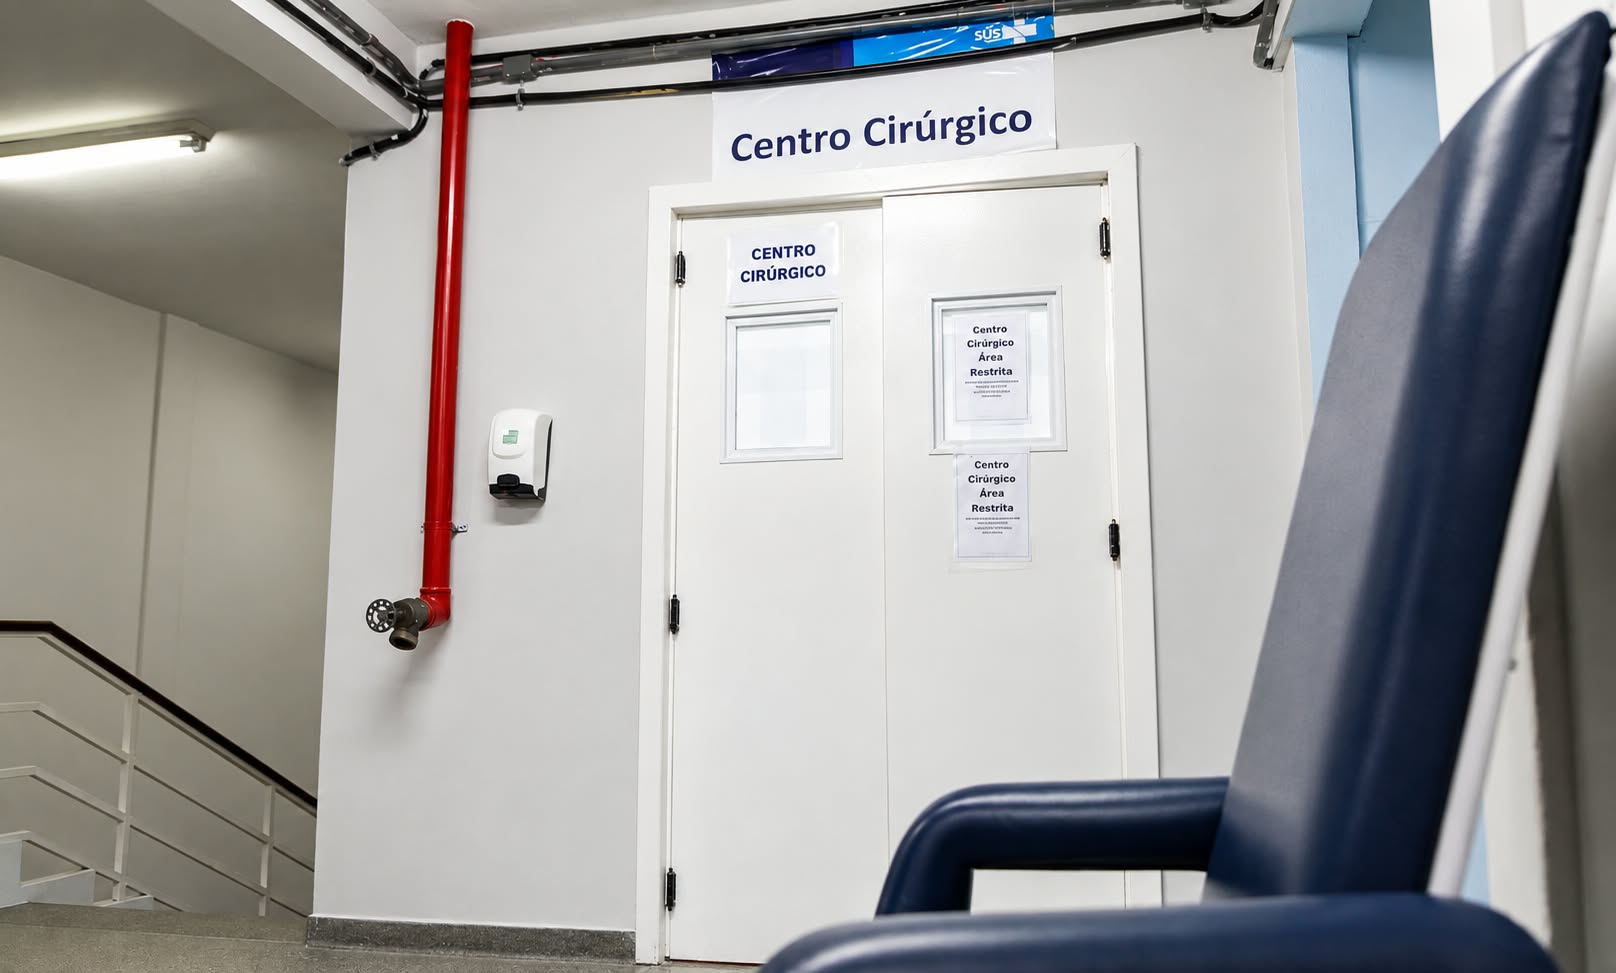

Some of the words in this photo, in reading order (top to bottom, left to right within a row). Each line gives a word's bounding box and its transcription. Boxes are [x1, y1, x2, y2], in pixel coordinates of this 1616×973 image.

[731, 126, 851, 162] Centro
[863, 105, 1033, 147] Cirúrgico
[751, 244, 816, 260] CENTRO
[740, 264, 826, 283] CIRÚRGICO
[973, 325, 1008, 334] Centro
[967, 338, 1014, 349] Cirúrgico
[978, 351, 1004, 362] Área
[970, 366, 1013, 377] Restrita
[974, 460, 1009, 469] Centro
[968, 474, 1016, 485] Cirúrgico
[979, 487, 1005, 498] Área
[971, 503, 1014, 513] Restrita
